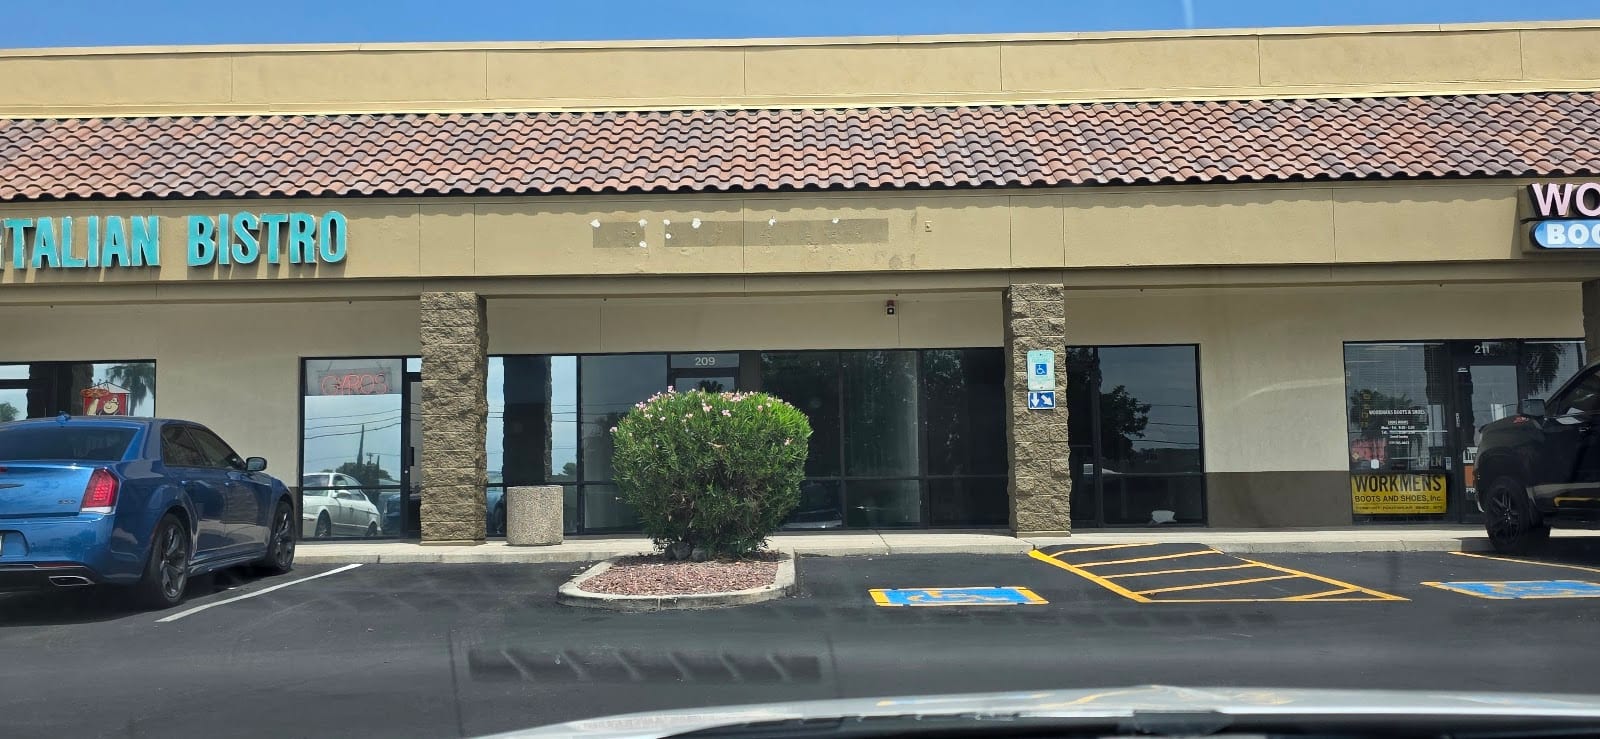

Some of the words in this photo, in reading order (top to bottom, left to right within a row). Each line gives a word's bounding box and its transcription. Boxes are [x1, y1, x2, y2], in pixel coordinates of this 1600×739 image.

[0, 214, 161, 270] TALIAN
[188, 211, 348, 267] BISTRO
[1474, 345, 1490, 354] 211
[695, 357, 716, 366] 209
[321, 373, 388, 395] GYROS
[1354, 475, 1442, 493] WORKMENS
